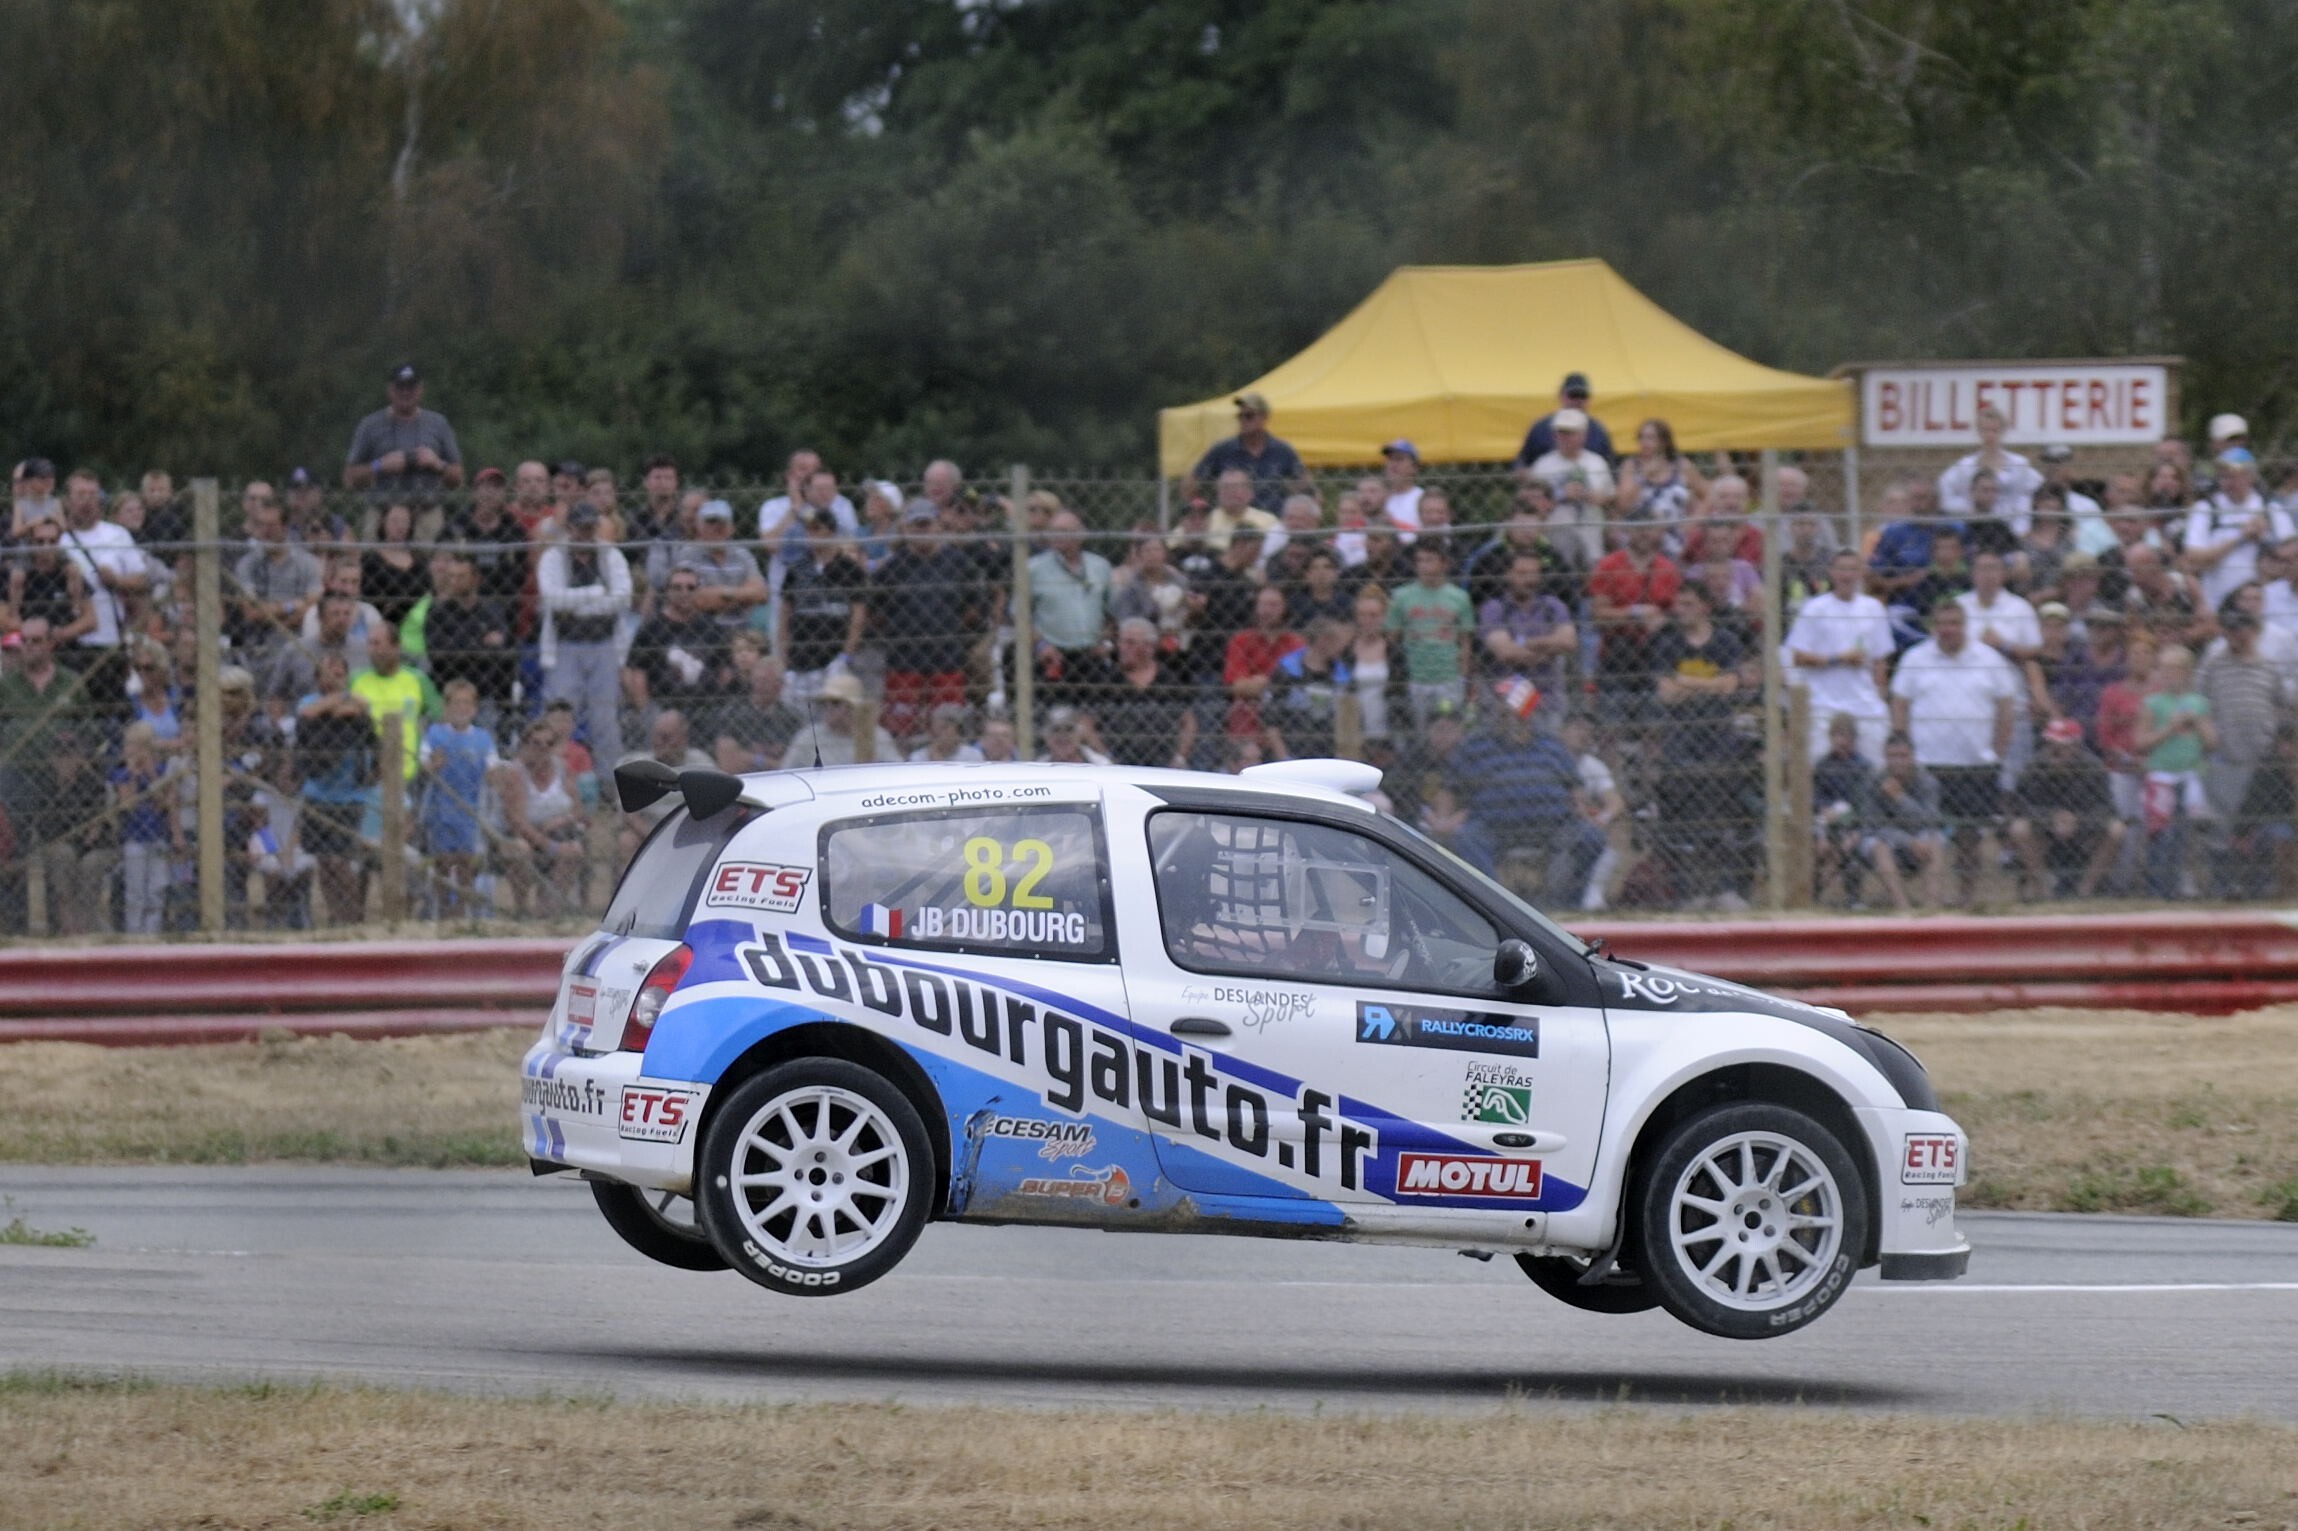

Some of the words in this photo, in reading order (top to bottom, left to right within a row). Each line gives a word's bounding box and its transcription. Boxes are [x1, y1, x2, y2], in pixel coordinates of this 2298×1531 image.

[1879, 379, 2151, 432] BILLETTERIE
[861, 785, 1051, 807] adecom-photo.com
[716, 867, 803, 898] ETS
[963, 836, 1054, 909] 82
[911, 906, 943, 937] JB
[952, 909, 1085, 944] DUBOURG
[1421, 1018, 1534, 1042] RALLYCROSSRX
[747, 933, 1371, 1193] dubourgauto.fr
[1465, 1071, 1534, 1088] FALEYRAS
[1467, 1061, 1502, 1074] Circuit
[1504, 1064, 1518, 1075] de
[623, 1092, 688, 1126] ETS
[1908, 1140, 1955, 1168] ETS
[1404, 1160, 1535, 1193] MOTUL
[743, 1240, 841, 1286] COOPER
[1769, 1253, 1850, 1326] COOPER
